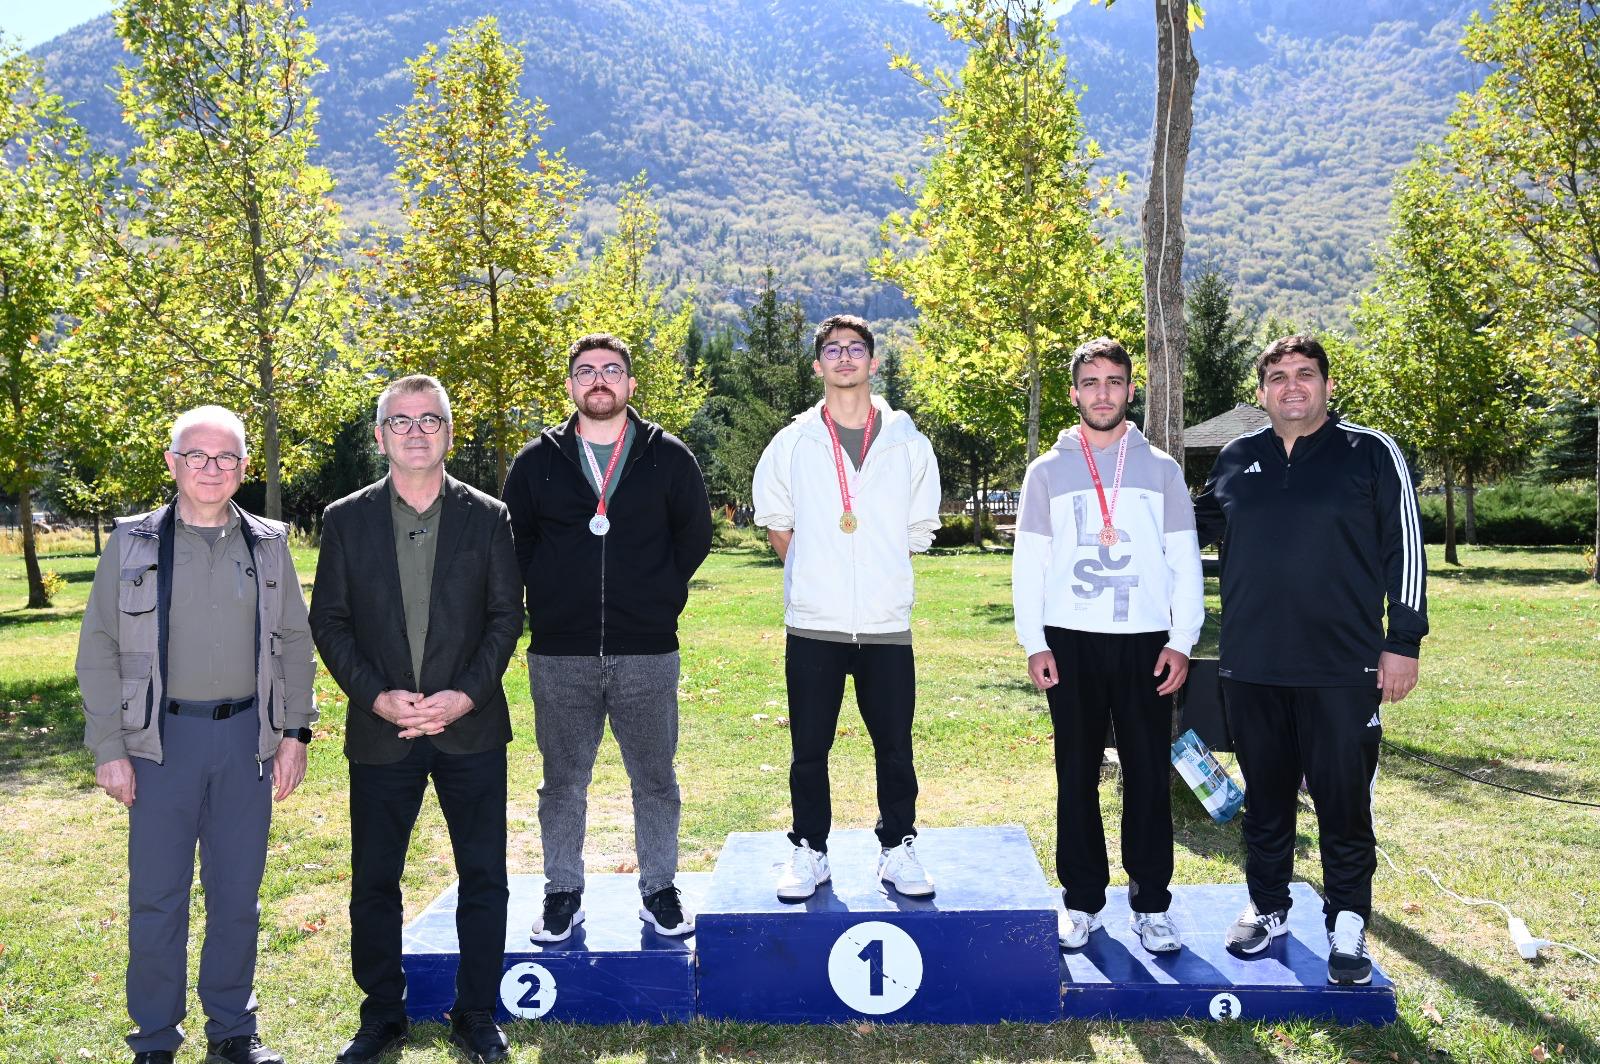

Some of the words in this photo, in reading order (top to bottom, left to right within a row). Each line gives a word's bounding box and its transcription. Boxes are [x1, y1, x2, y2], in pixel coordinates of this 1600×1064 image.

[857, 939, 883, 996] 1
[517, 973, 541, 1009] 2
[1218, 998, 1232, 1018] 3
